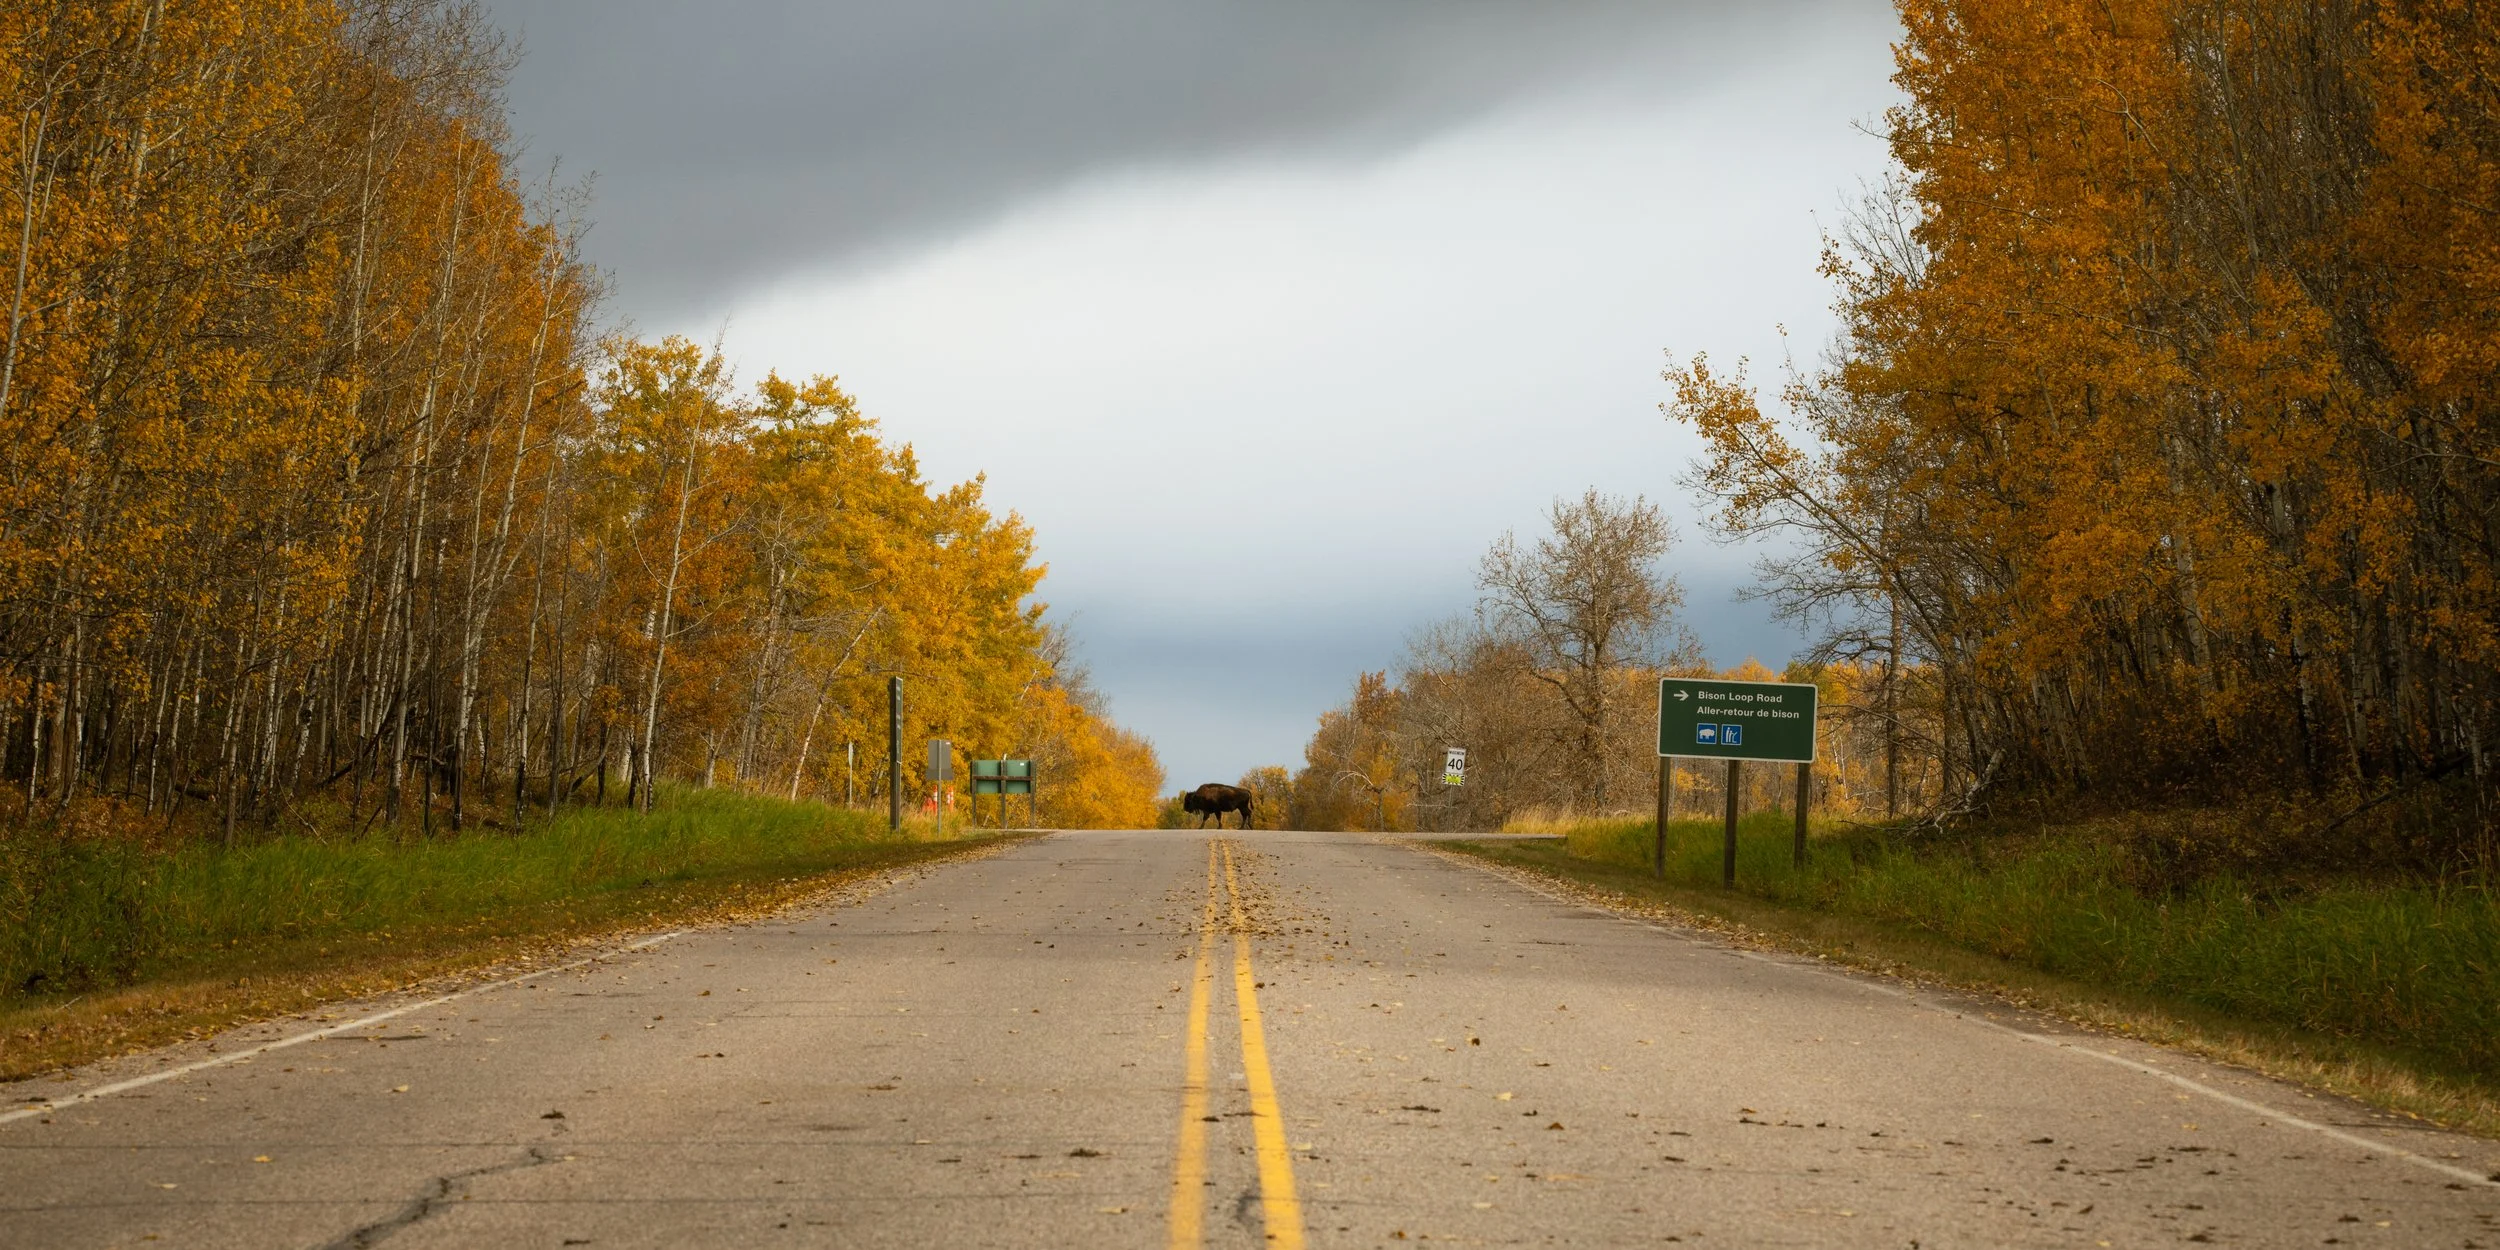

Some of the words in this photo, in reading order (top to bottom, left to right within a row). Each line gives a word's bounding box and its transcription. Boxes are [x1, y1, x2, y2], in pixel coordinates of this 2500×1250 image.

[1698, 691, 1725, 700] Bison
[1729, 692, 1754, 703] Loop
[1756, 693, 1782, 703] Road
[1697, 706, 1754, 717] Aller-retour
[1757, 709, 1769, 717] de
[1772, 710, 1799, 719] bison
[1448, 758, 1463, 770] 40
